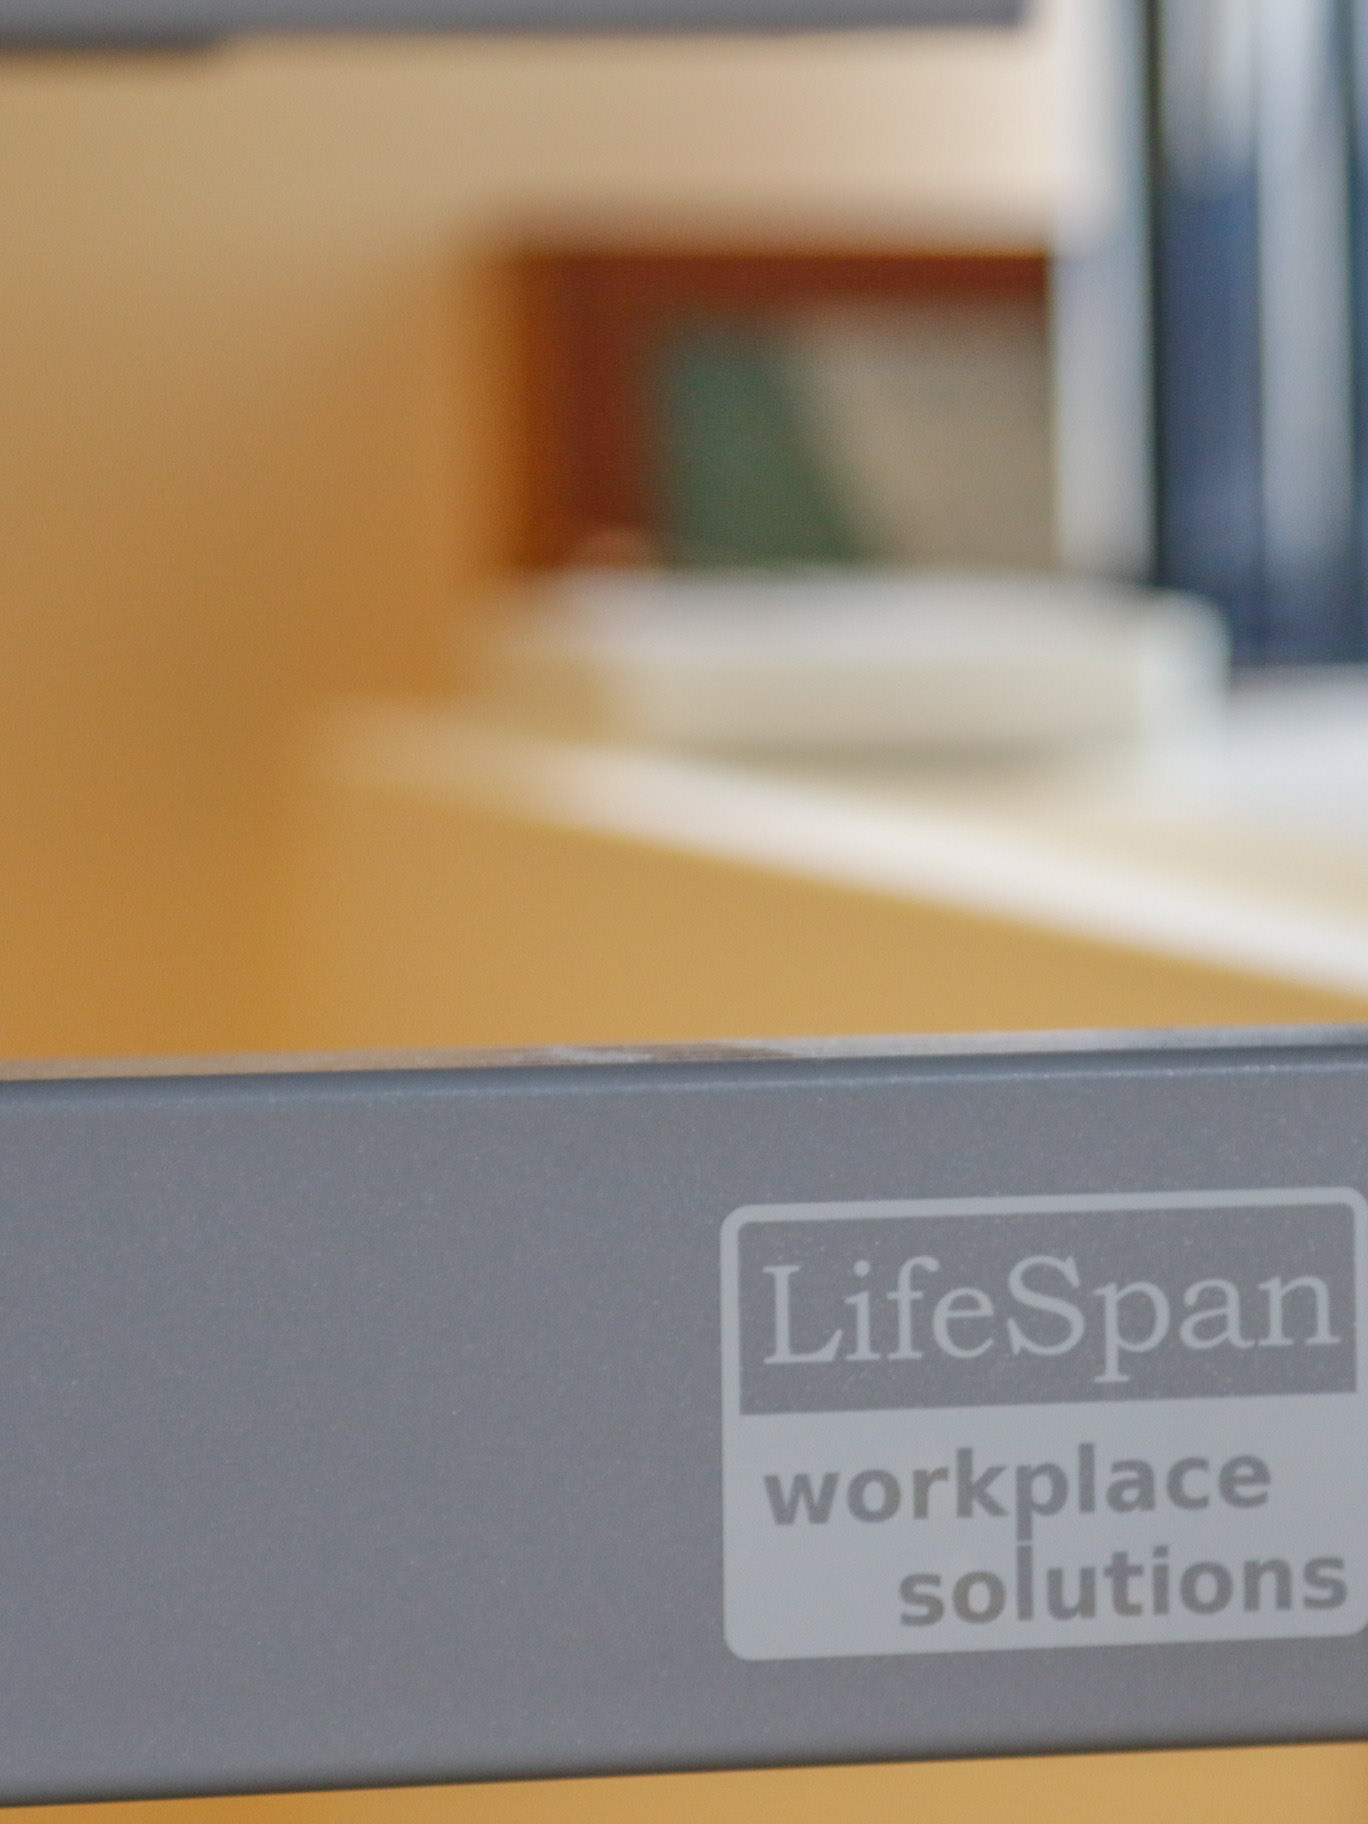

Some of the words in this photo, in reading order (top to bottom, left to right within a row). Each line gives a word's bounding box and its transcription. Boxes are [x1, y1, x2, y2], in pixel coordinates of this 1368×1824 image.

[763, 1255, 1340, 1383] LifeSpan
[763, 1443, 1271, 1541] workplace
[899, 1545, 1348, 1627] solutions
